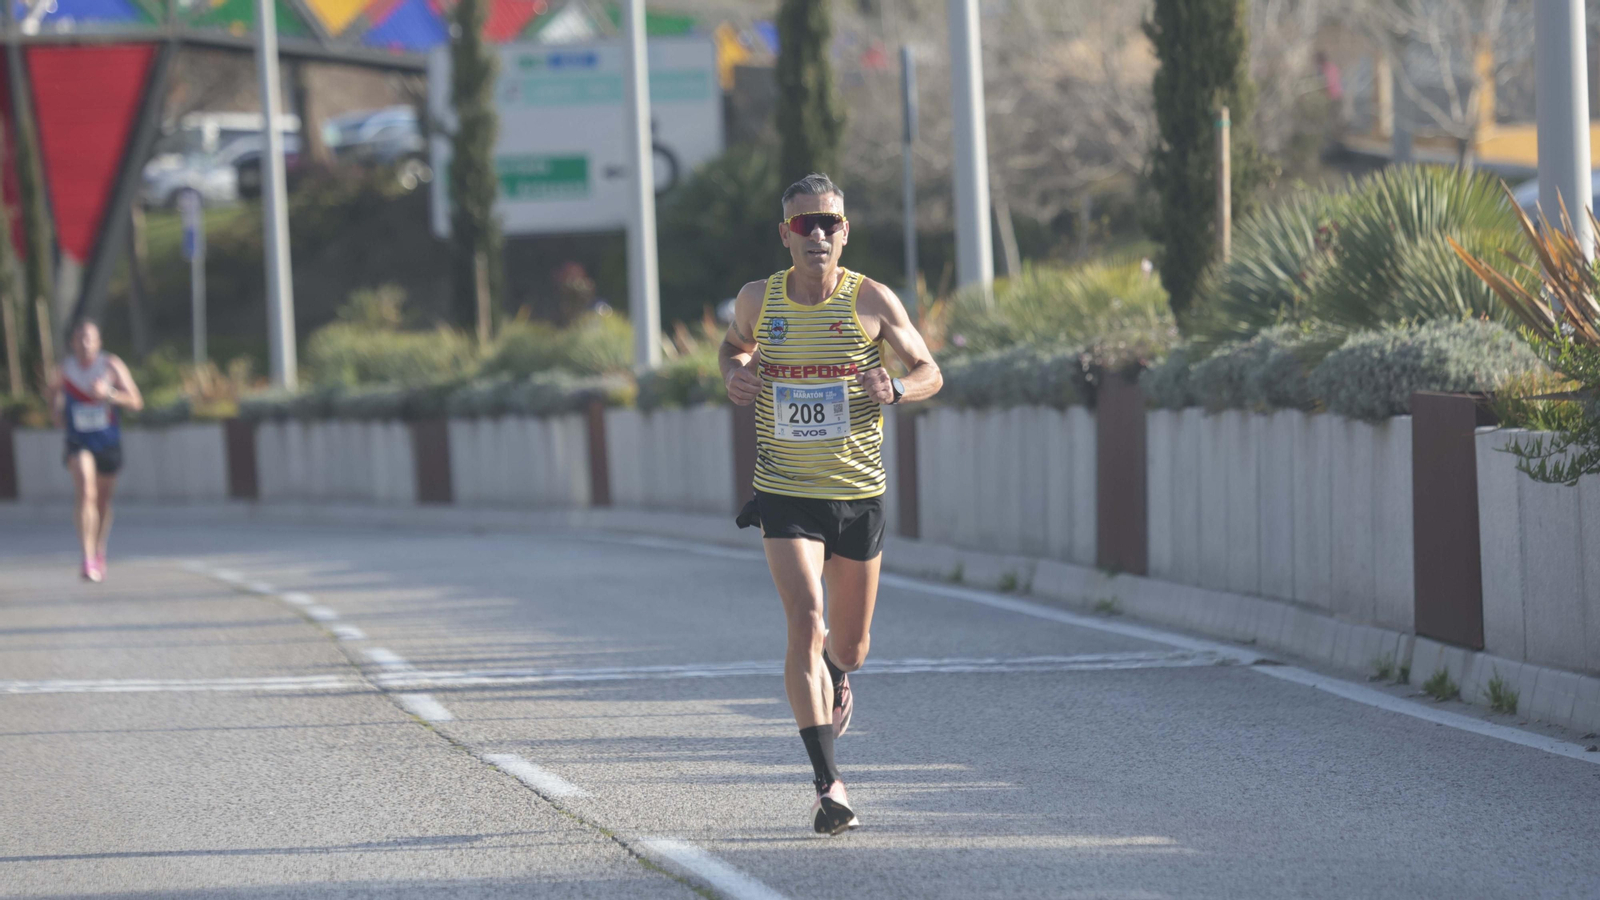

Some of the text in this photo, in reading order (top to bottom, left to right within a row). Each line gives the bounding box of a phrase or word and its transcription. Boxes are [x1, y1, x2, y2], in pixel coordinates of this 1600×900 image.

[793, 391, 823, 399] MARATÓN
[788, 402, 826, 424] 208
[791, 429, 827, 437] EVOS
